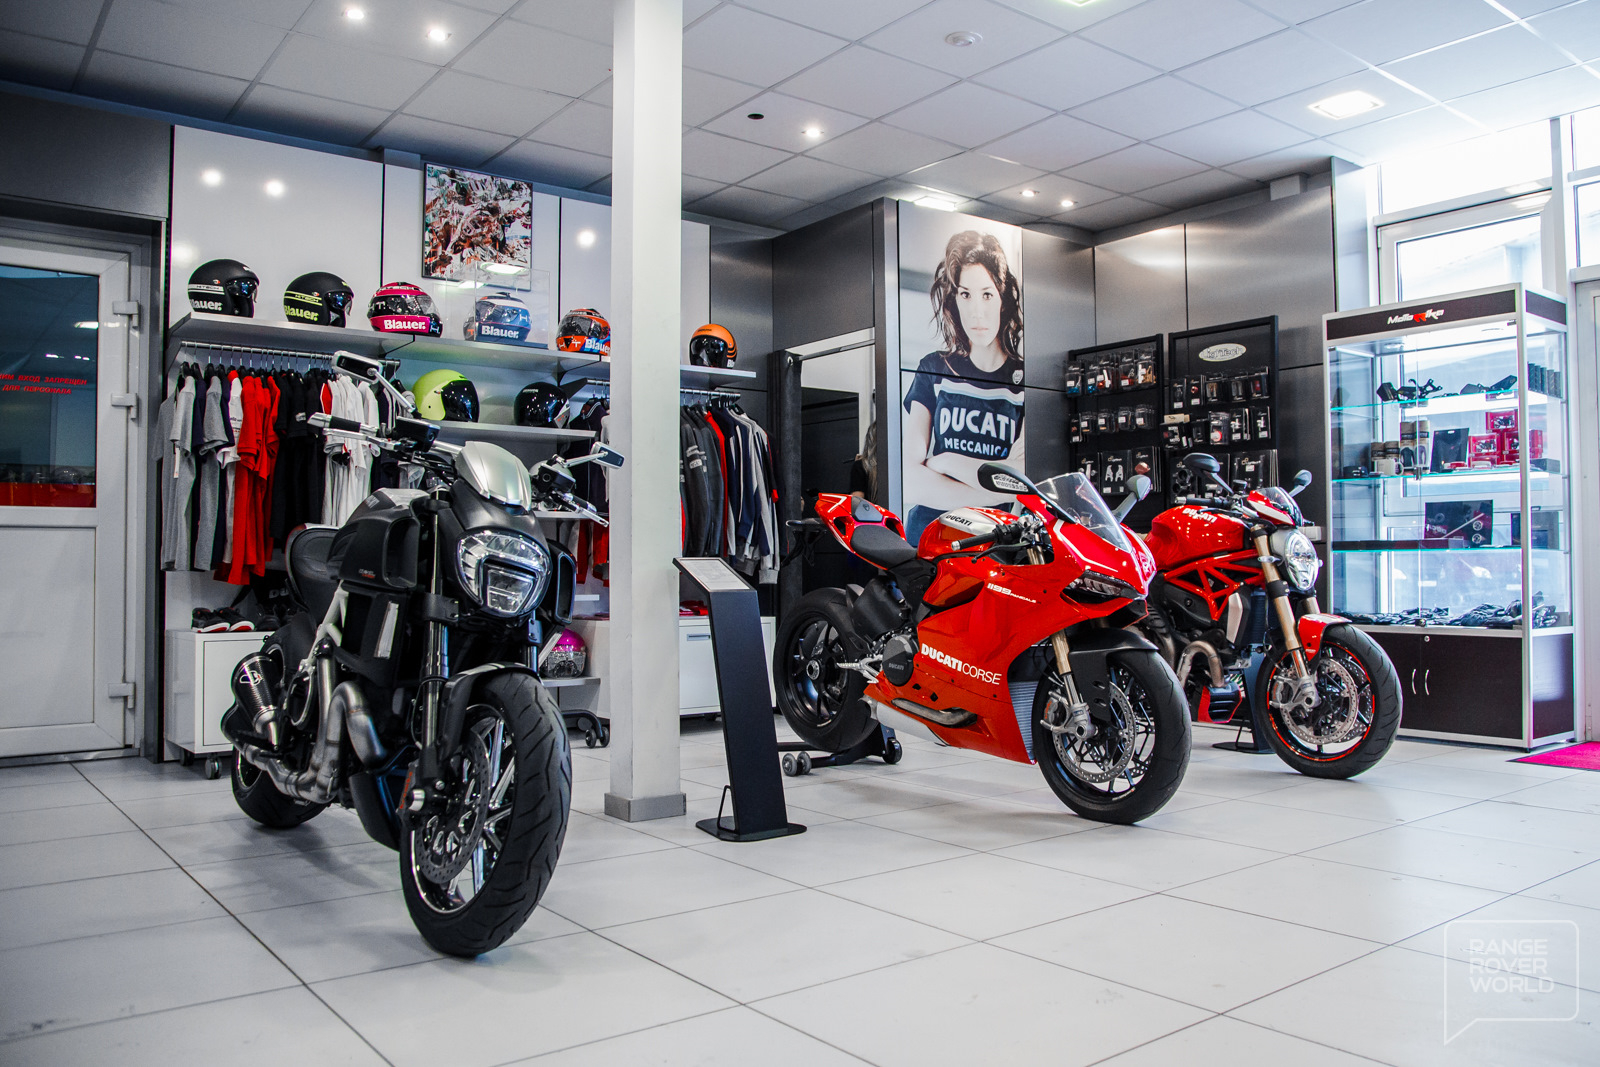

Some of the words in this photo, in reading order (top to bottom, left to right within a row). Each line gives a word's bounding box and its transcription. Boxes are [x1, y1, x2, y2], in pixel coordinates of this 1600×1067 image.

[383, 319, 426, 331] Blauer.
[481, 325, 519, 340] Blauer.
[18, 374, 41, 383] ВХОД
[44, 376, 88, 385] ЗАПРЕЩЕН
[2, 384, 20, 392] ДЛЯ
[24, 385, 72, 394] ПЕРСОНАЛА
[940, 407, 1016, 444] DUCATI
[944, 437, 1008, 457] MECCANICA
[945, 514, 973, 527] DUCATI
[921, 643, 963, 672] DUCATI
[962, 662, 1003, 686] CORSE
